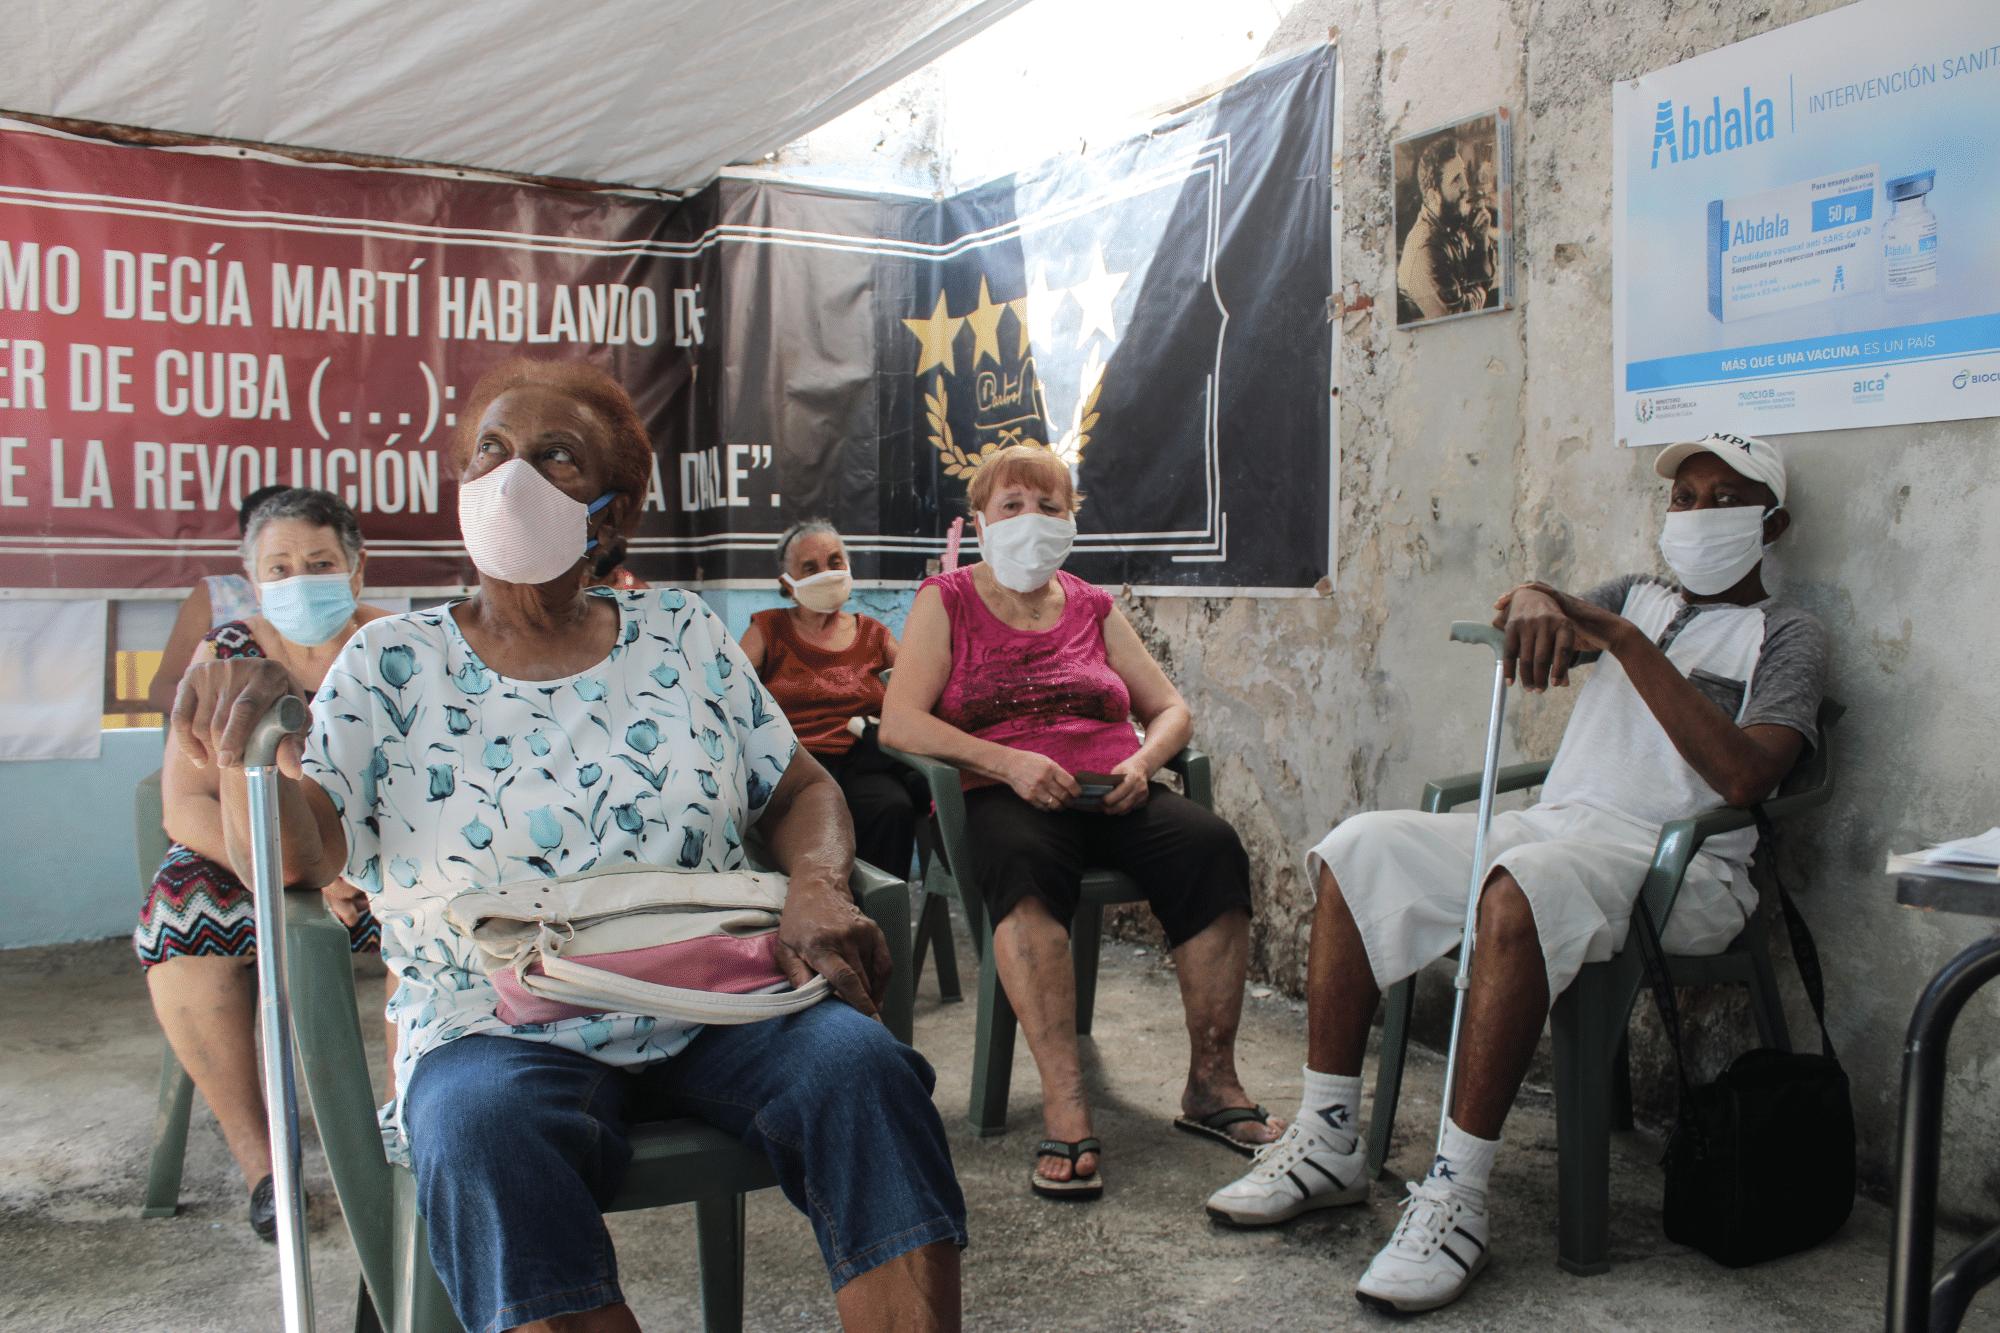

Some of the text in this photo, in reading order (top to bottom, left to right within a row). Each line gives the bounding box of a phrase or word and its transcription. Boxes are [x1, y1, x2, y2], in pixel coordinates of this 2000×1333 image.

[1809, 45, 2000, 115] INTERVENCIÓN SANIT
[1651, 86, 1775, 169] Abdala
[1733, 213, 1789, 246] Abdala
[1828, 204, 1842, 223] 50
[0, 240, 81, 315] MO
[104, 242, 253, 327] DECÍA
[272, 258, 427, 337] MARTÍ
[438, 275, 657, 346] HABLANDO
[69, 342, 135, 414] DE
[155, 349, 291, 421] CUBA
[1721, 333, 1936, 372] MÁS QUE UNA VACUNA ES UN PAÍS
[50, 438, 114, 509] LA
